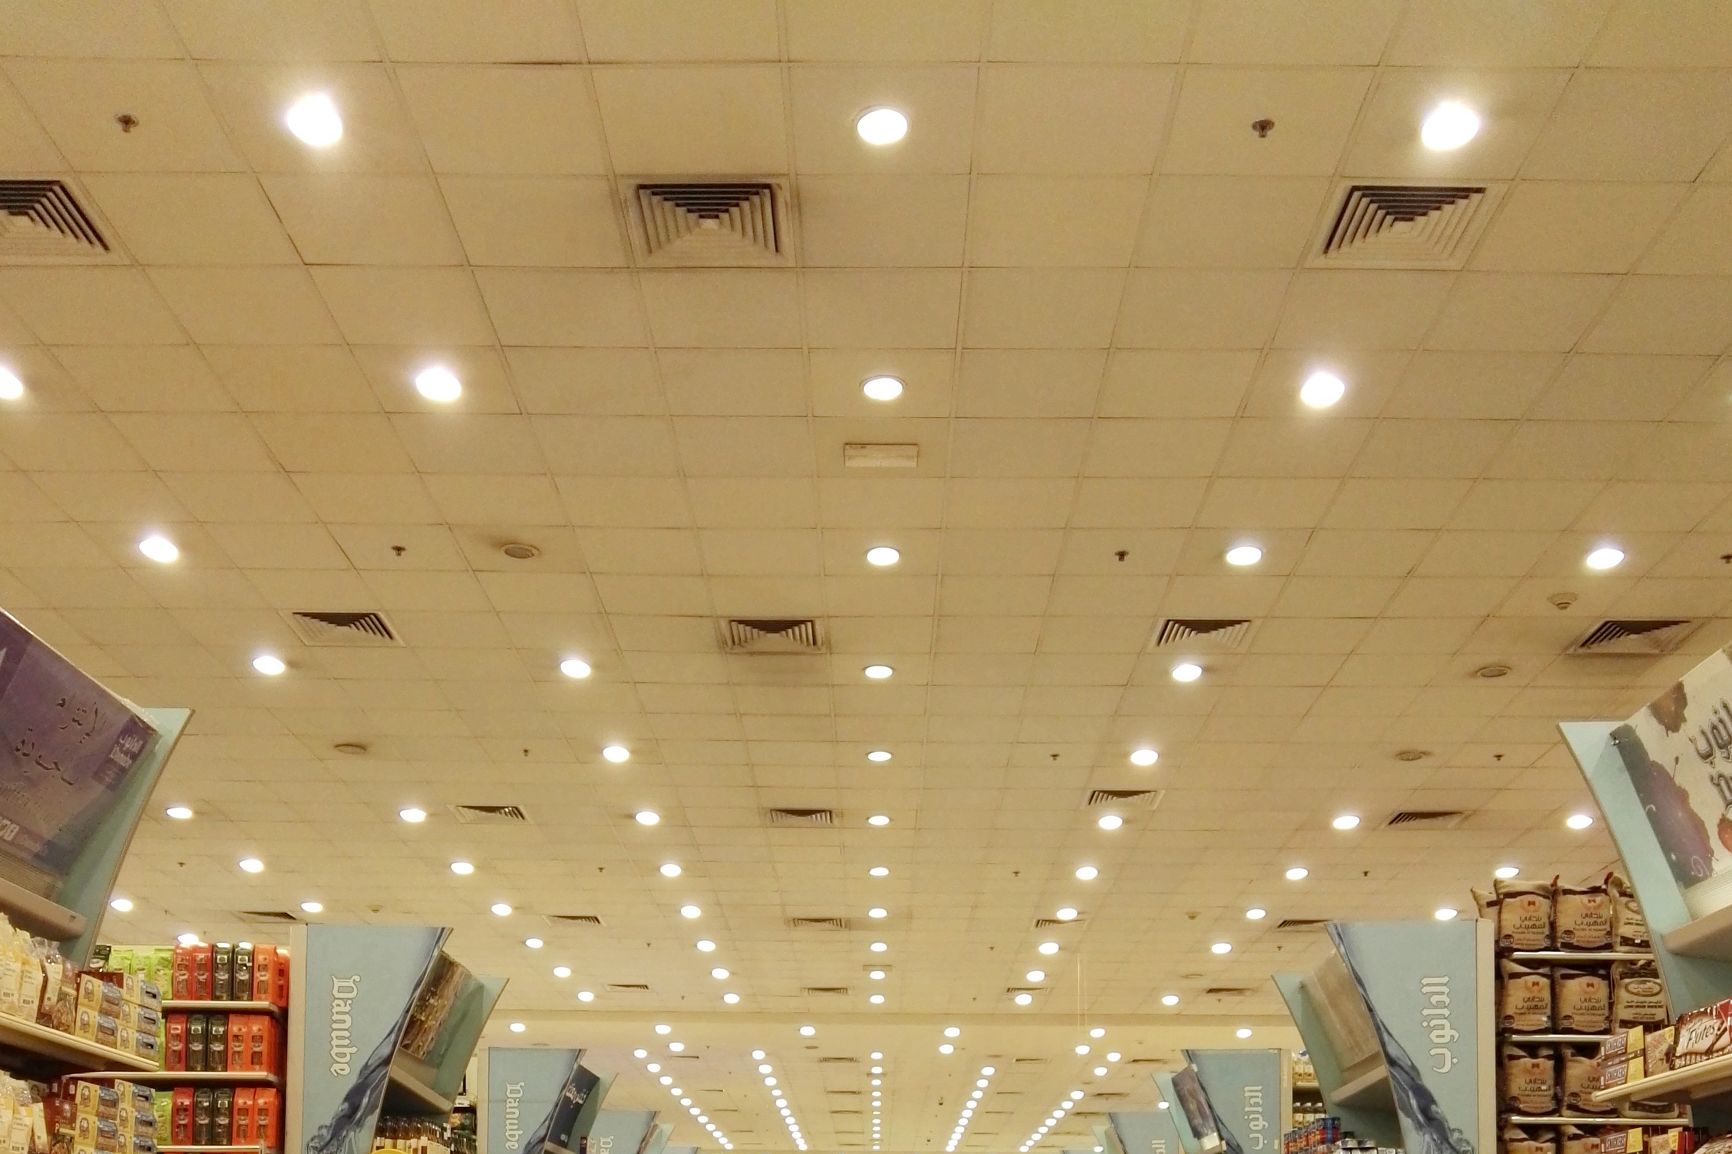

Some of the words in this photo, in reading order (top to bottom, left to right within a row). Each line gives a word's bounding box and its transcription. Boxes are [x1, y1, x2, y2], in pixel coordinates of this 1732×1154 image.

[327, 974, 362, 1077] Danube
[1420, 975, 1459, 1074] الدانوب
[505, 1082, 527, 1150] Danube
[1242, 1085, 1269, 1151] الدانوب
